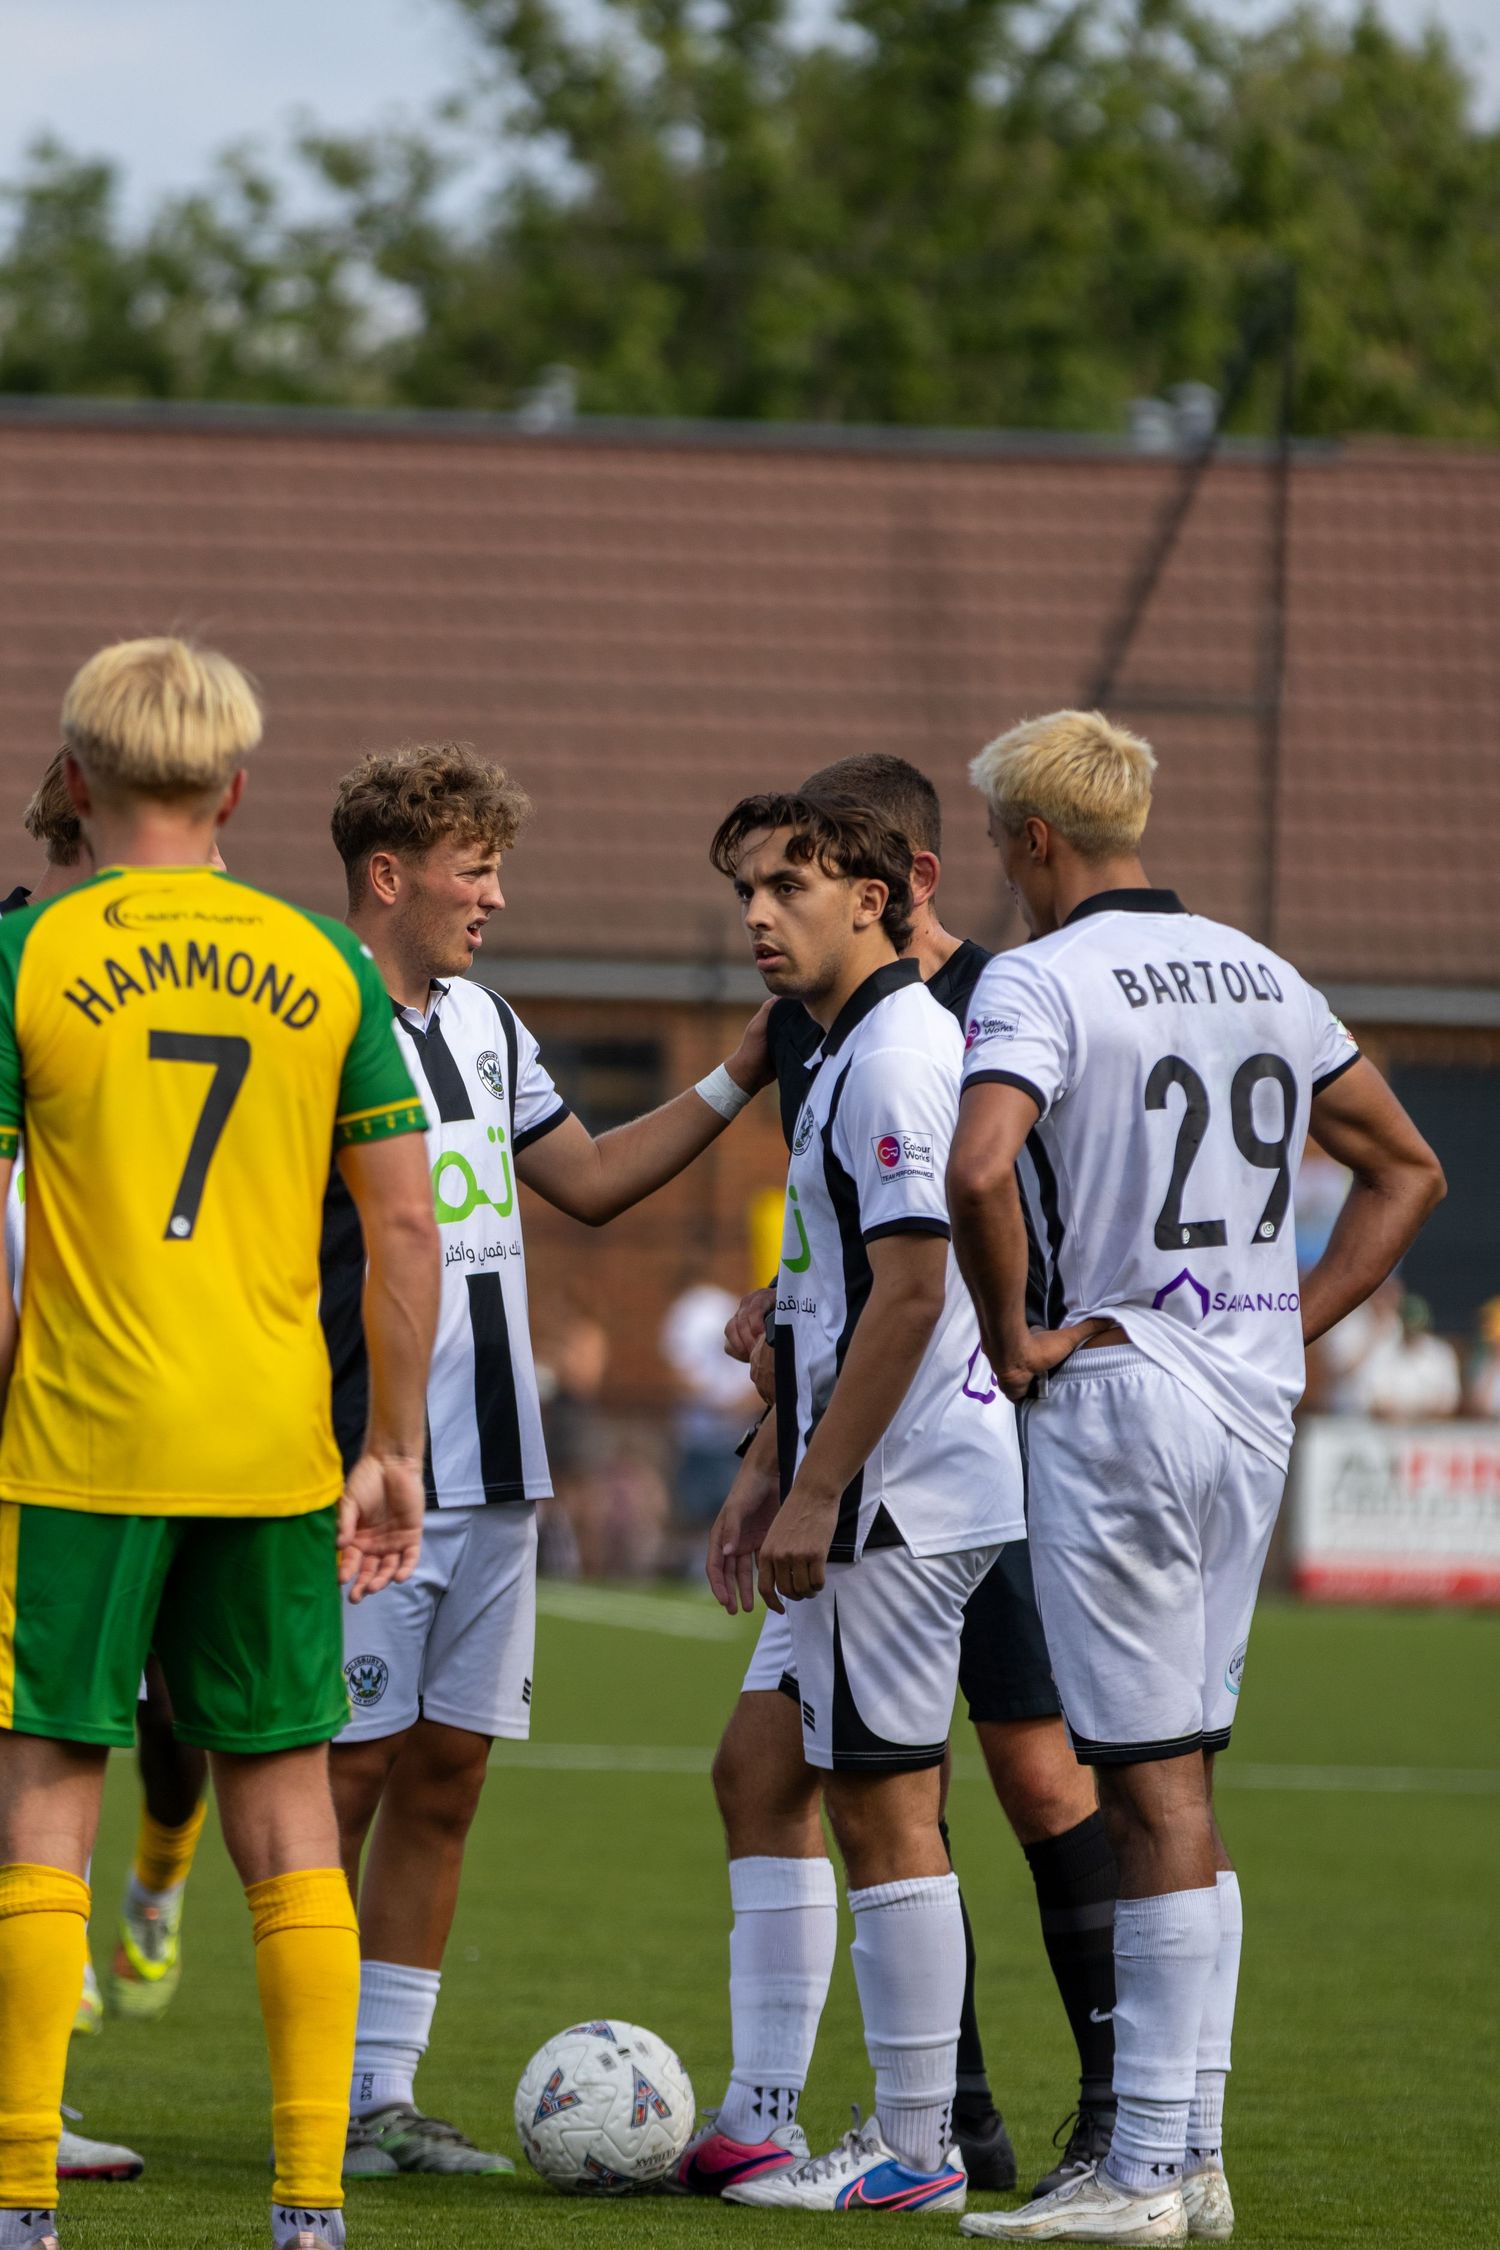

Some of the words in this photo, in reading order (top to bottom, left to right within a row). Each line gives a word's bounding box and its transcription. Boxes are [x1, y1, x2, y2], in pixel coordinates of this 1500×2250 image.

[63, 940, 321, 1031] HAMMOND
[1112, 960, 1284, 1009] BARTOLO
[148, 1029, 252, 1241] 7
[903, 1141, 931, 1154] Colour
[905, 1151, 930, 1163] Works
[1145, 1053, 1298, 1251] 29
[896, 1169, 934, 1179] PERFORMANCE
[445, 1240, 475, 1267] وأكثر
[478, 1241, 506, 1266] رقمي
[801, 1297, 817, 1318] بنك
